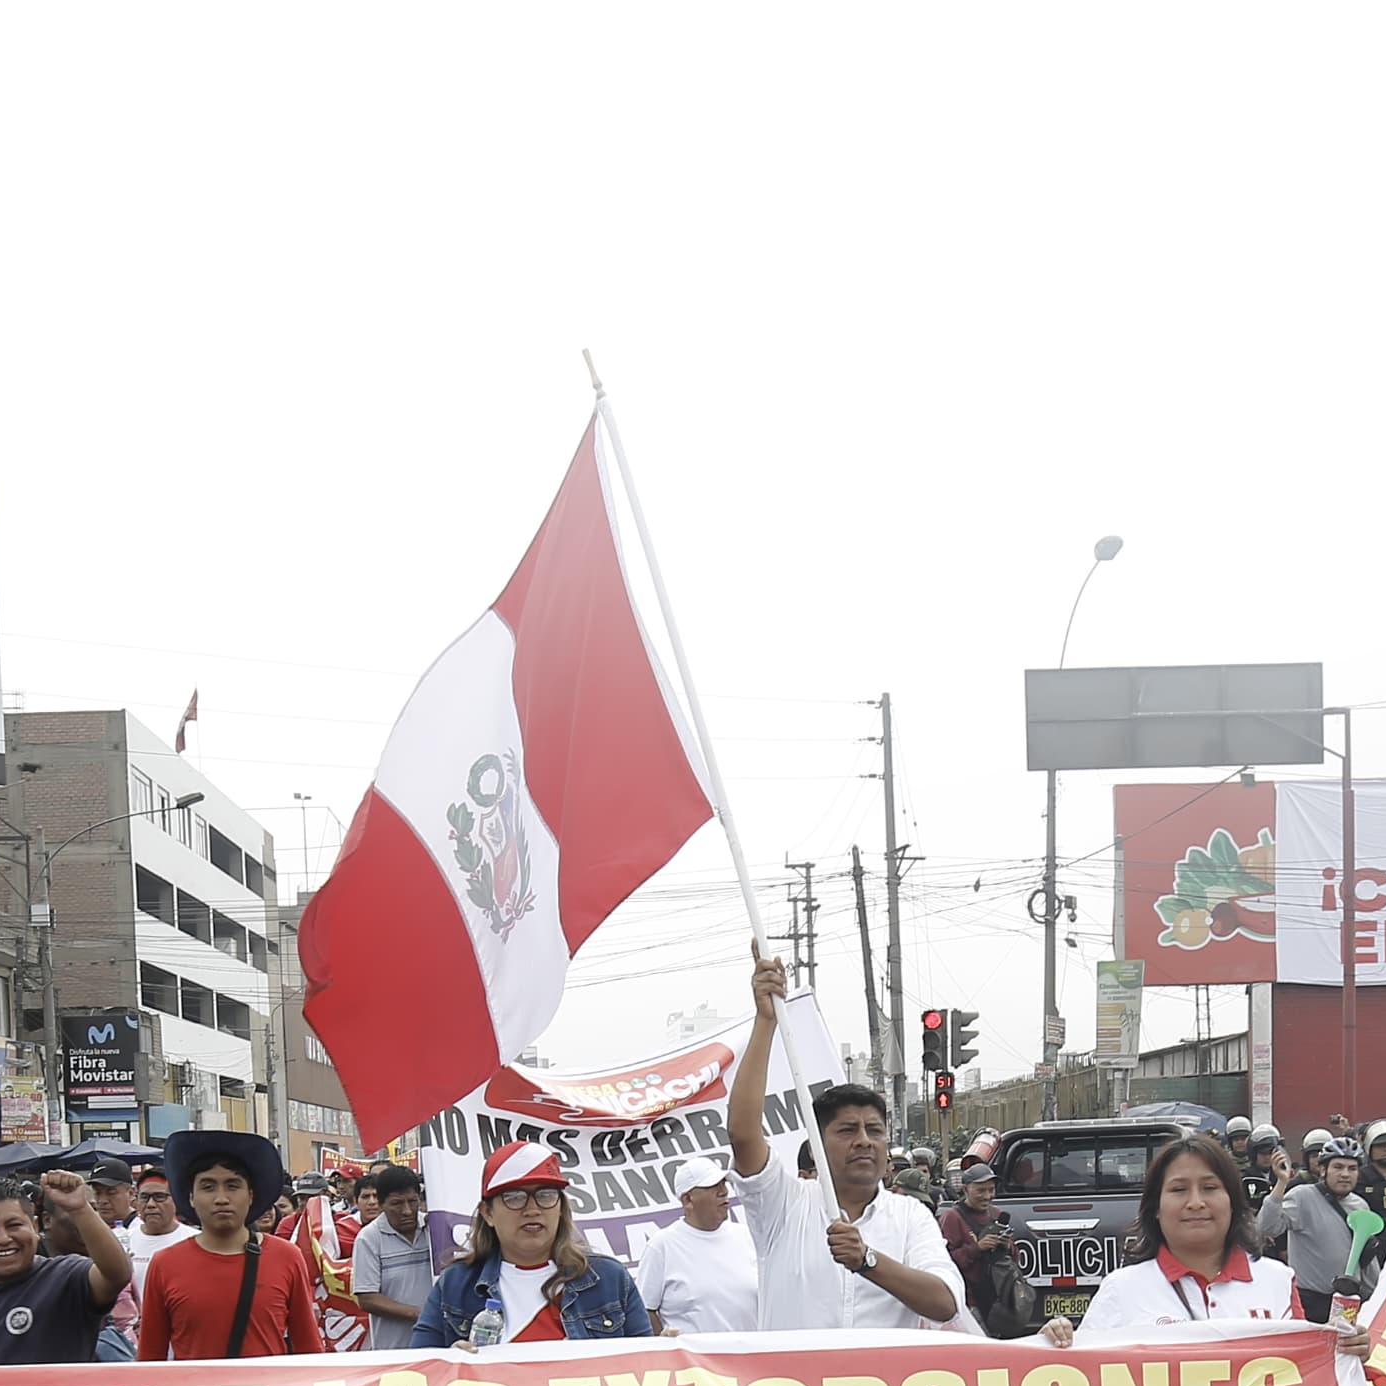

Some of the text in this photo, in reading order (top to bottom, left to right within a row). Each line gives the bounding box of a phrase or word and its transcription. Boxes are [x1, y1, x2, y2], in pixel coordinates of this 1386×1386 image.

[70, 1055, 106, 1069] Fibra
[70, 1069, 134, 1082] Movistar
[937, 1076, 951, 1088] 51
[420, 1105, 470, 1156] NO
[1012, 1236, 1138, 1280] OLICI
